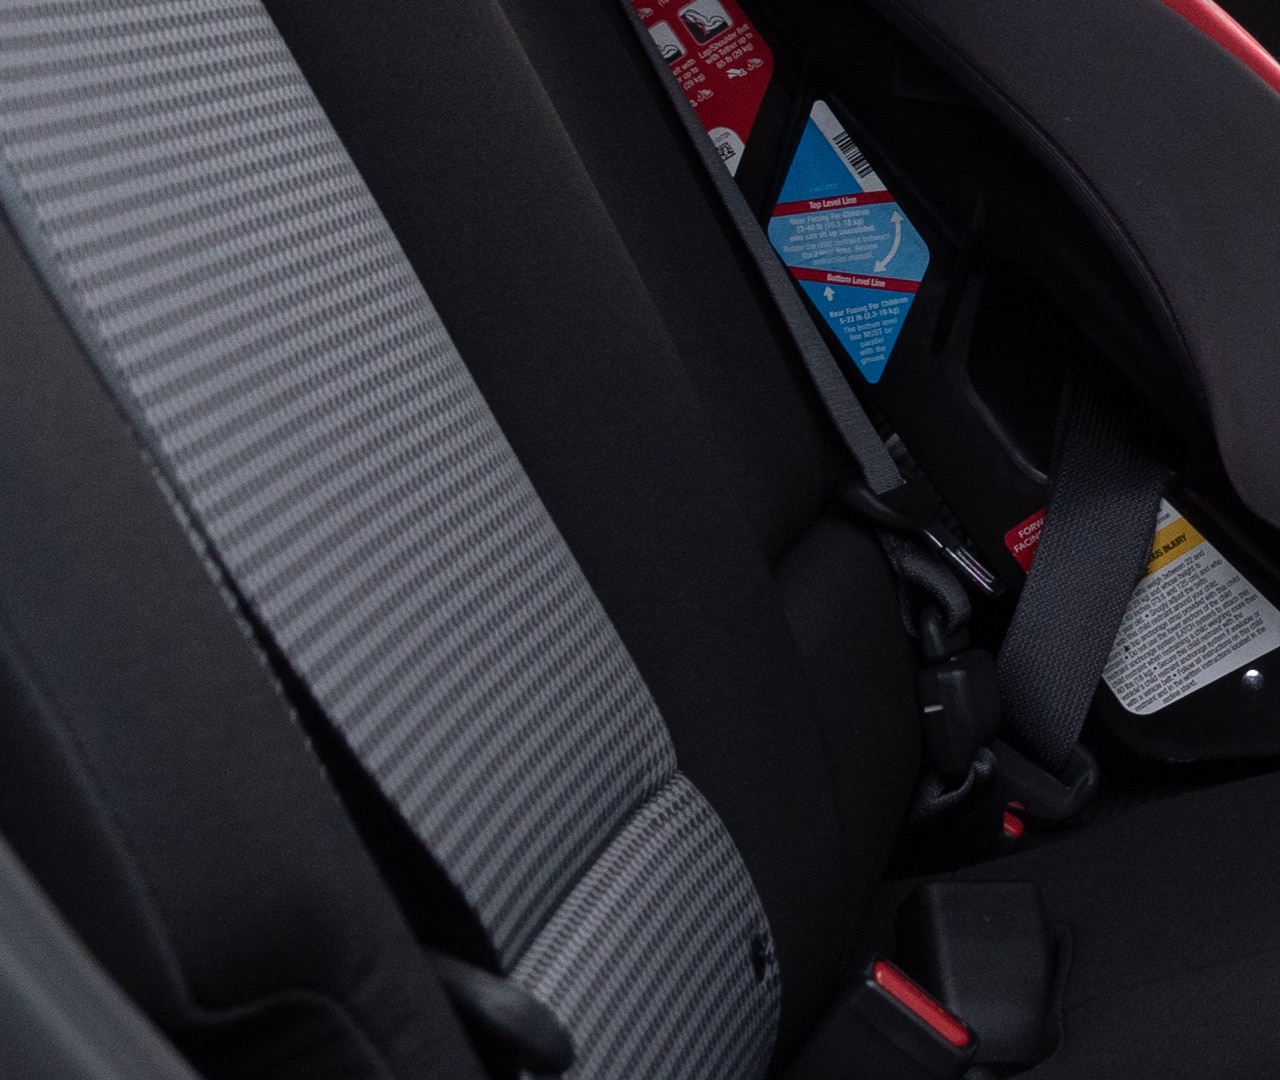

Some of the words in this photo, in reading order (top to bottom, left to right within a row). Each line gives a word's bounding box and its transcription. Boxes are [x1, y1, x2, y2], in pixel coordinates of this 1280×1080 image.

[697, 29, 738, 59] Lap/Shoulder
[736, 22, 749, 34] Belt
[704, 52, 720, 65] with
[718, 40, 738, 56] Tether
[736, 35, 747, 45] up
[745, 31, 753, 39] to
[808, 200, 821, 210] Top
[822, 197, 841, 207] Level
[842, 195, 857, 204] Line
[806, 213, 829, 223] Facing
[826, 273, 851, 283] Bottom
[852, 276, 870, 285] Level
[870, 278, 886, 287] Line
[845, 303, 868, 315] Facing
[868, 301, 879, 309] For
[880, 295, 908, 307] Children
[1016, 516, 1046, 539] FORW
[1161, 532, 1187, 553] INJURY
[1162, 561, 1185, 579] between
[1184, 556, 1193, 565] 22
[1192, 549, 1204, 560] and
[1165, 585, 1177, 596] and
[1199, 565, 1210, 575] and
[1209, 557, 1222, 569] who
[1149, 600, 1169, 617] Snugly
[1167, 590, 1186, 605] adjust
[1184, 584, 1194, 594] the
